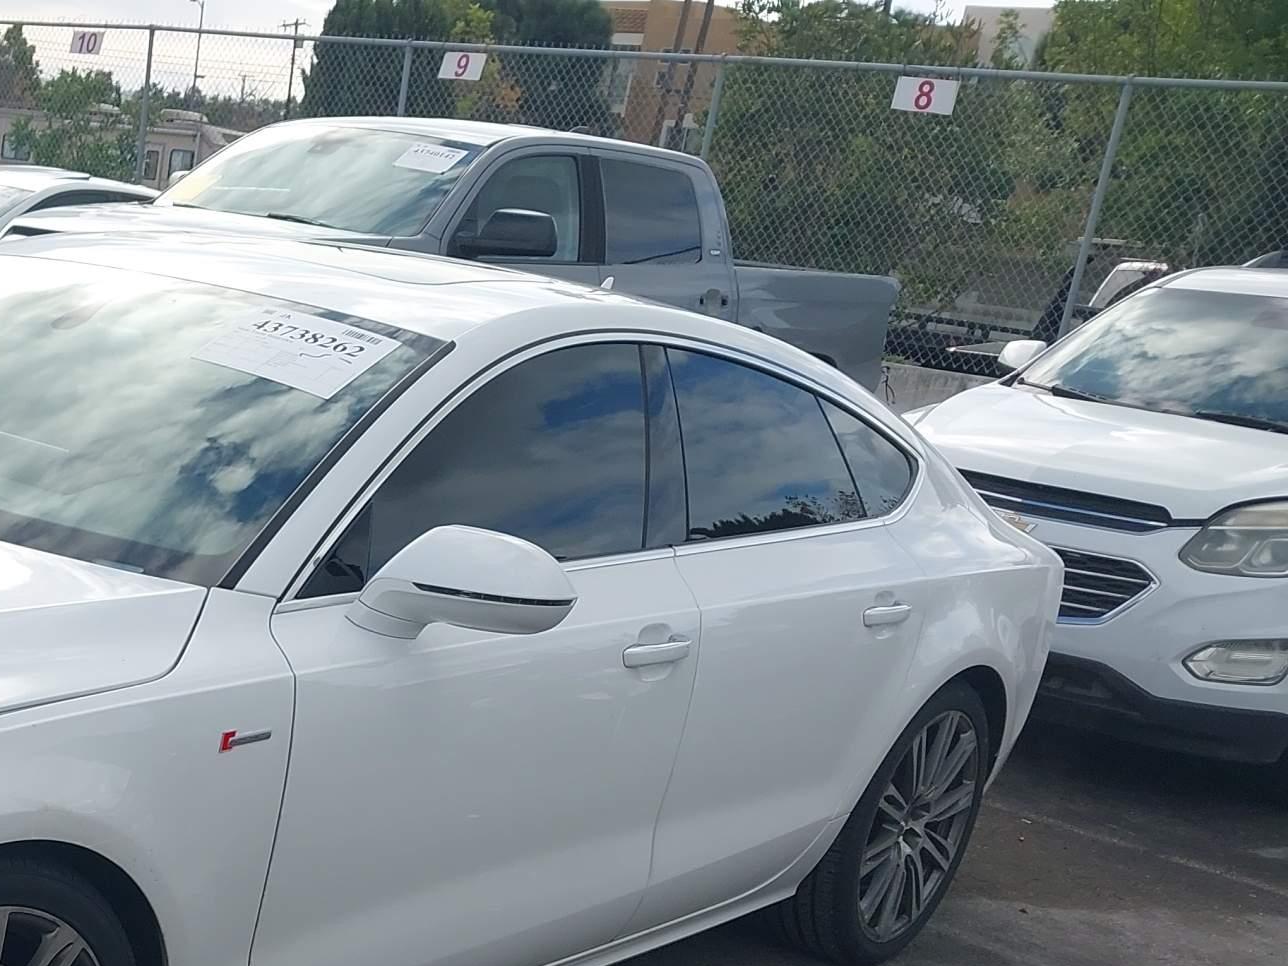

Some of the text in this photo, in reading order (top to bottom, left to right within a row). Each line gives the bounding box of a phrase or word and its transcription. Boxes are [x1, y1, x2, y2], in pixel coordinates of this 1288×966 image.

[78, 32, 98, 54] 10
[454, 53, 470, 77] 9
[914, 80, 935, 110] 8
[252, 319, 366, 358] 43738262
